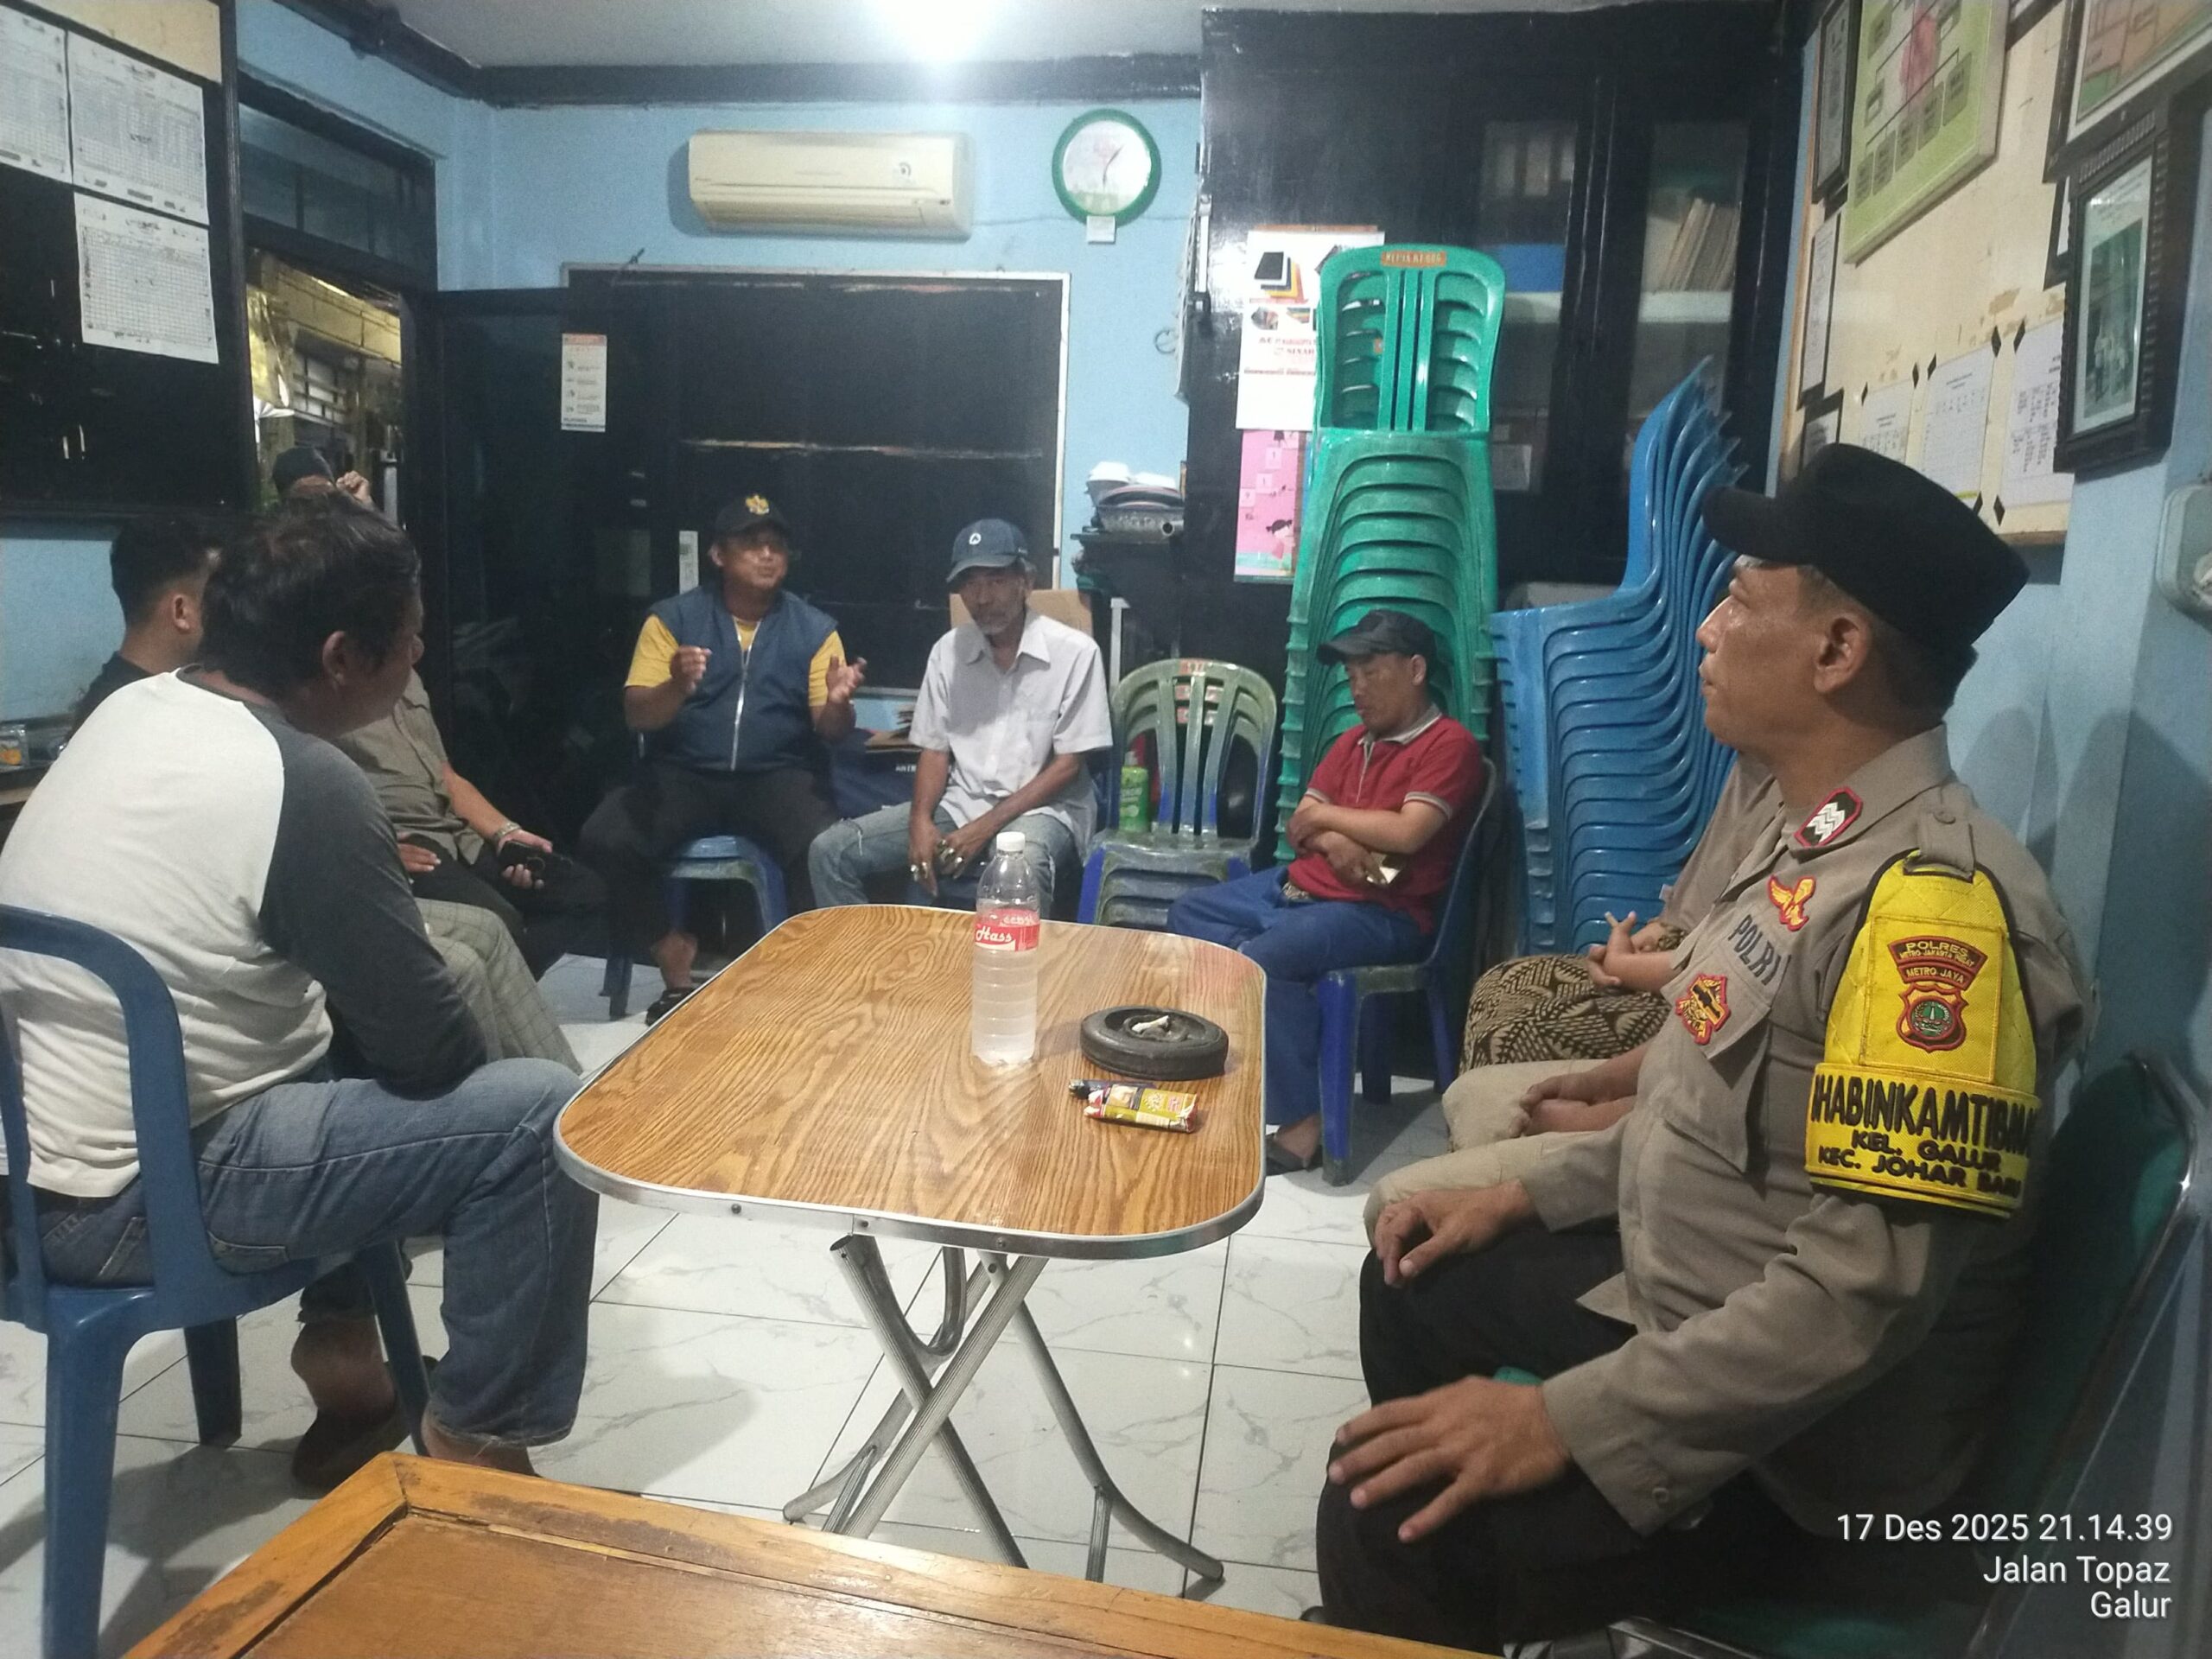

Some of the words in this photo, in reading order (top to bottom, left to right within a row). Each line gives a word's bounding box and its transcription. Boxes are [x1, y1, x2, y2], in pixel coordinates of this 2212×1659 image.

[975, 925, 1013, 943] Hass
[1728, 914, 1781, 986] POLRI
[1905, 940, 1969, 957] POLRES
[1906, 967, 1936, 977] METRO
[1940, 969, 1965, 983] JAYA
[1818, 1145, 1861, 1169] KEC.
[1872, 1155, 1967, 1188] JOHAR
[1917, 1140, 2002, 1173] GALUR
